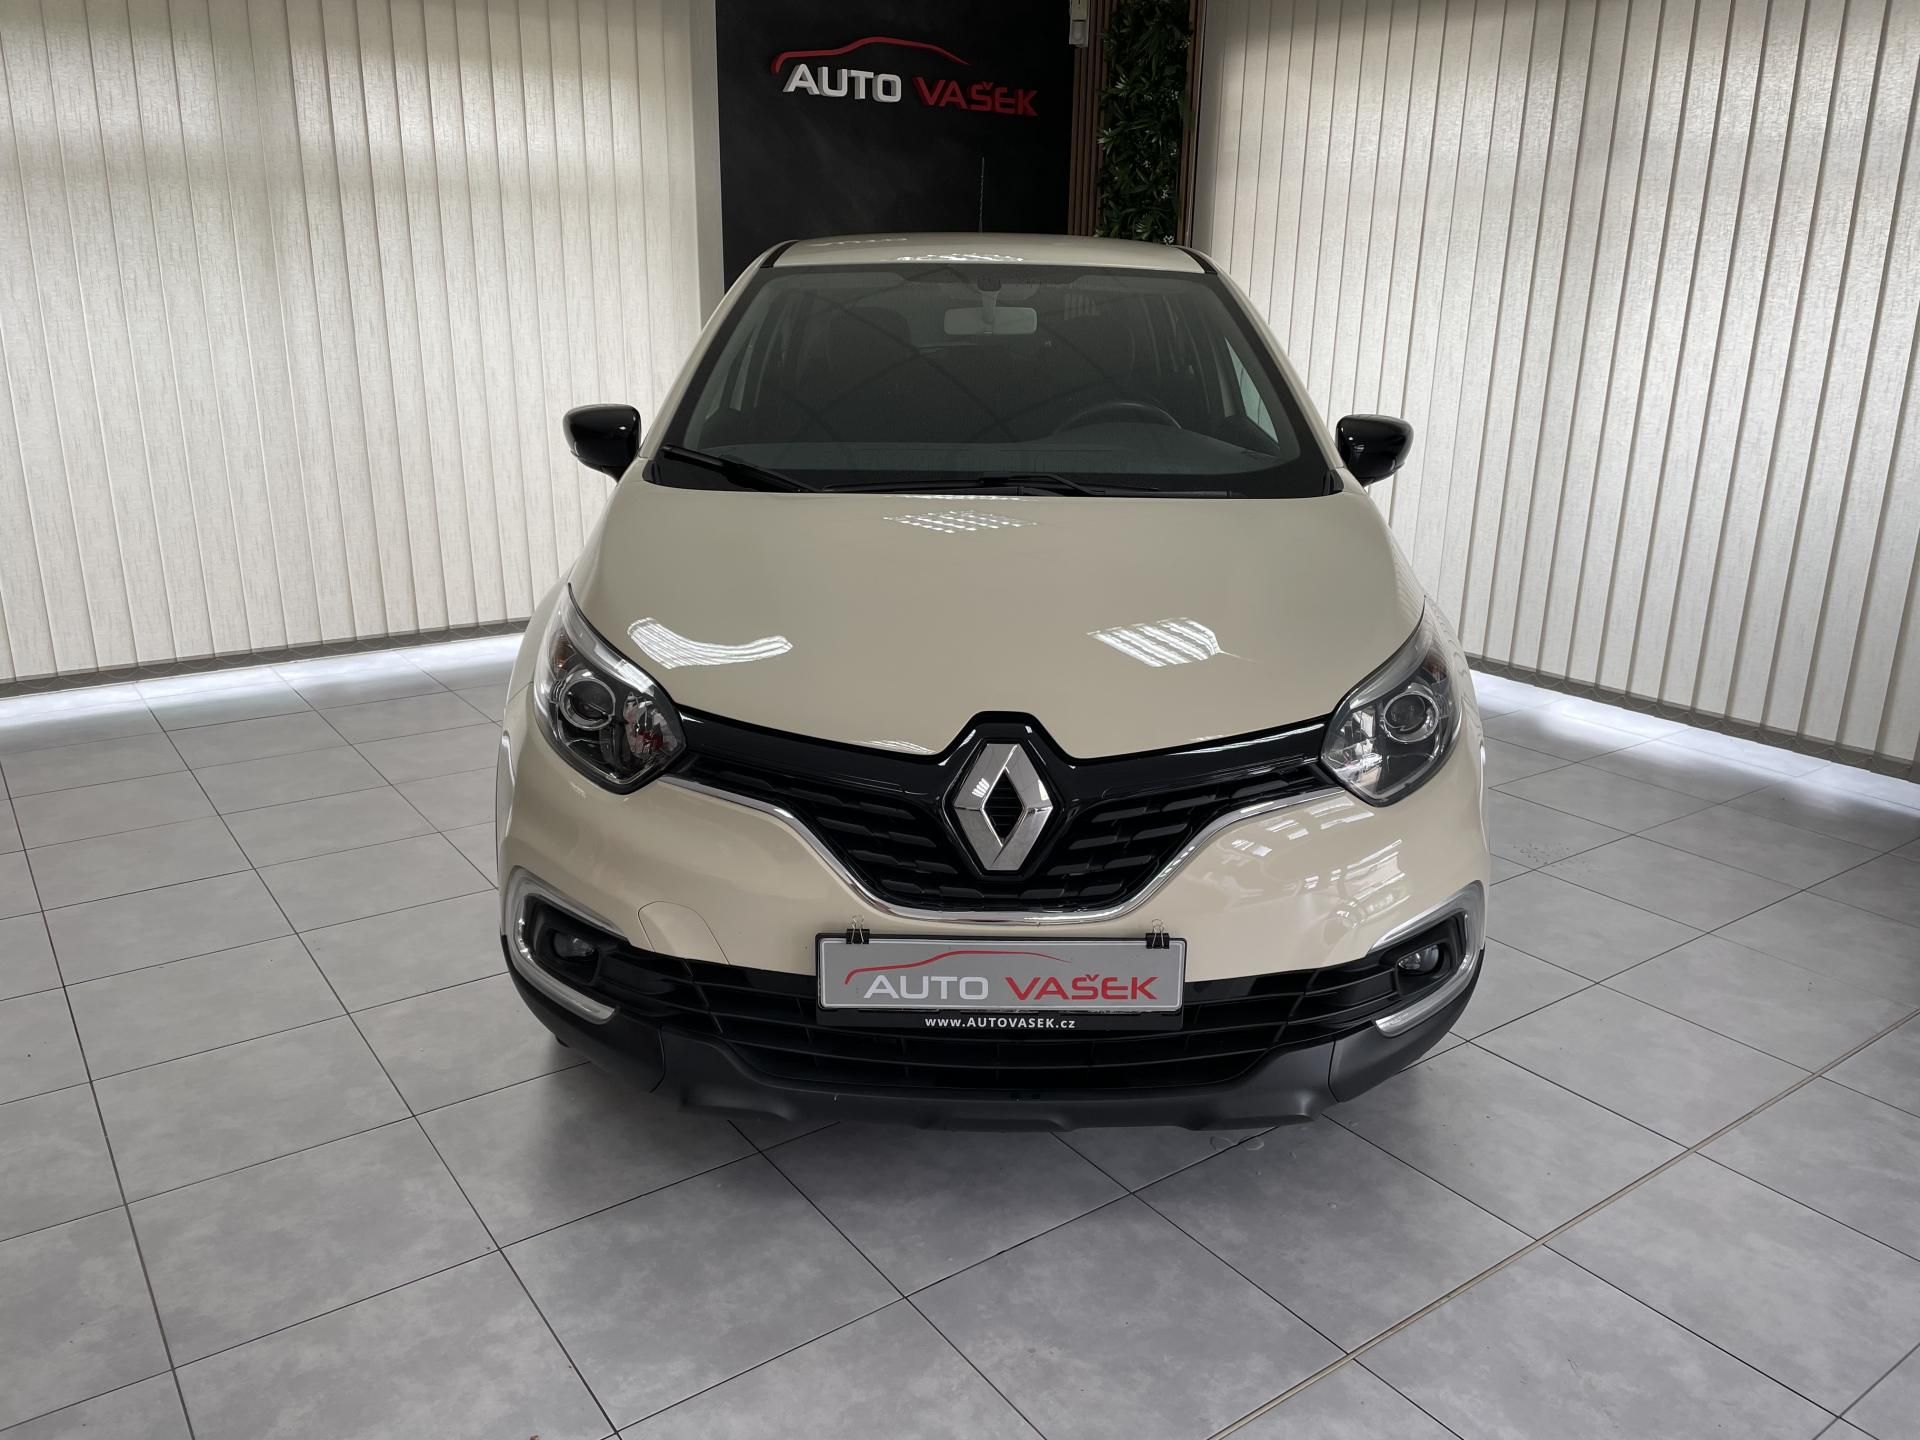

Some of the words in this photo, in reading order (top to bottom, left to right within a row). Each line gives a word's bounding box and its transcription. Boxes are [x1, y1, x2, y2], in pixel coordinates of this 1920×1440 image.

[783, 63, 902, 103] AUTO
[912, 76, 1038, 116] VAŠEK
[863, 974, 988, 1000] AUTO
[1005, 973, 1158, 1000] VAŠEK
[925, 1017, 1076, 1029] www.AUTOVASEK.cz
